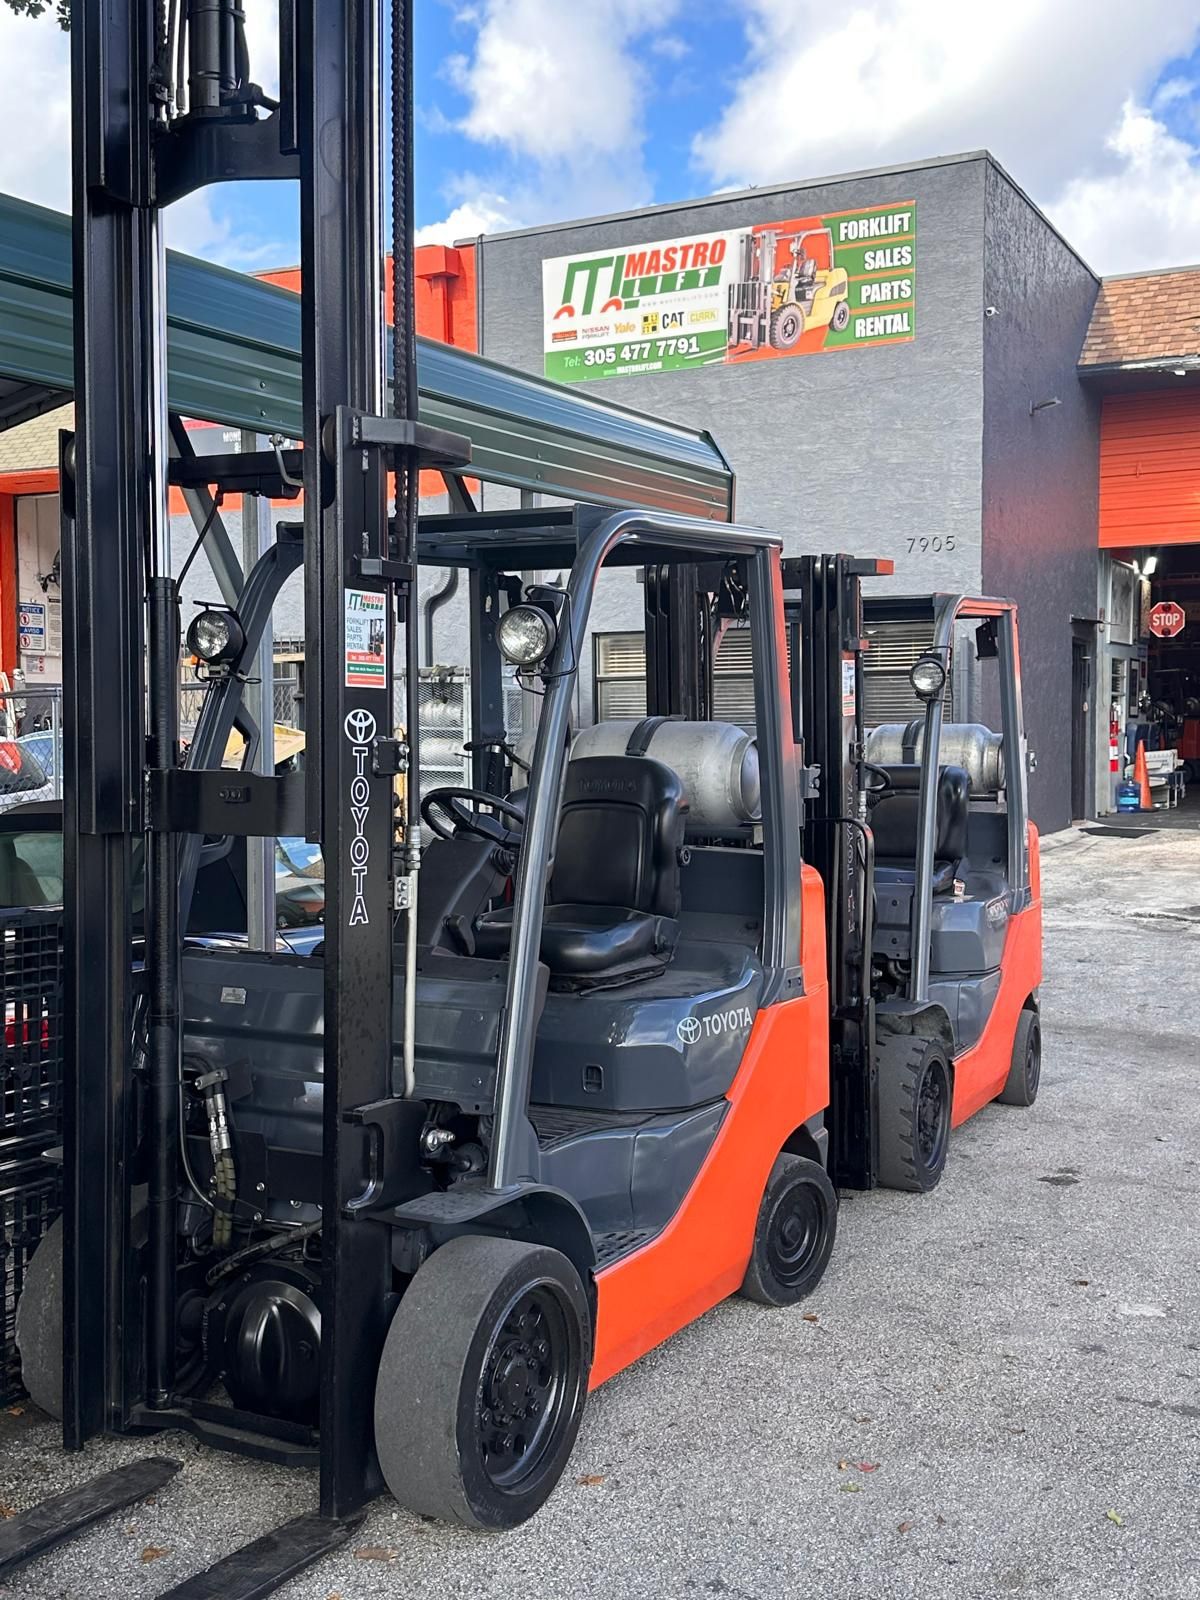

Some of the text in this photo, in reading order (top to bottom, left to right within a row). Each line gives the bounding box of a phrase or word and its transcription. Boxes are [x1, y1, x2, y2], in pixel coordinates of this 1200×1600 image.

[839, 212, 912, 241] FORKLIFT
[624, 239, 727, 278] MASTRO
[864, 246, 912, 271] SALES
[632, 268, 709, 297] LIFT
[861, 279, 912, 304] PARTS
[581, 325, 609, 334] NISSAN
[662, 312, 685, 329] CAT
[855, 312, 911, 338] RENTAL
[564, 336, 700, 367] Tel: 305 477 7791
[906, 535, 956, 553] 7905
[1152, 613, 1180, 626] STOP
[349, 746, 370, 925] TOYOTA
[702, 1006, 753, 1037] TOYOTA
